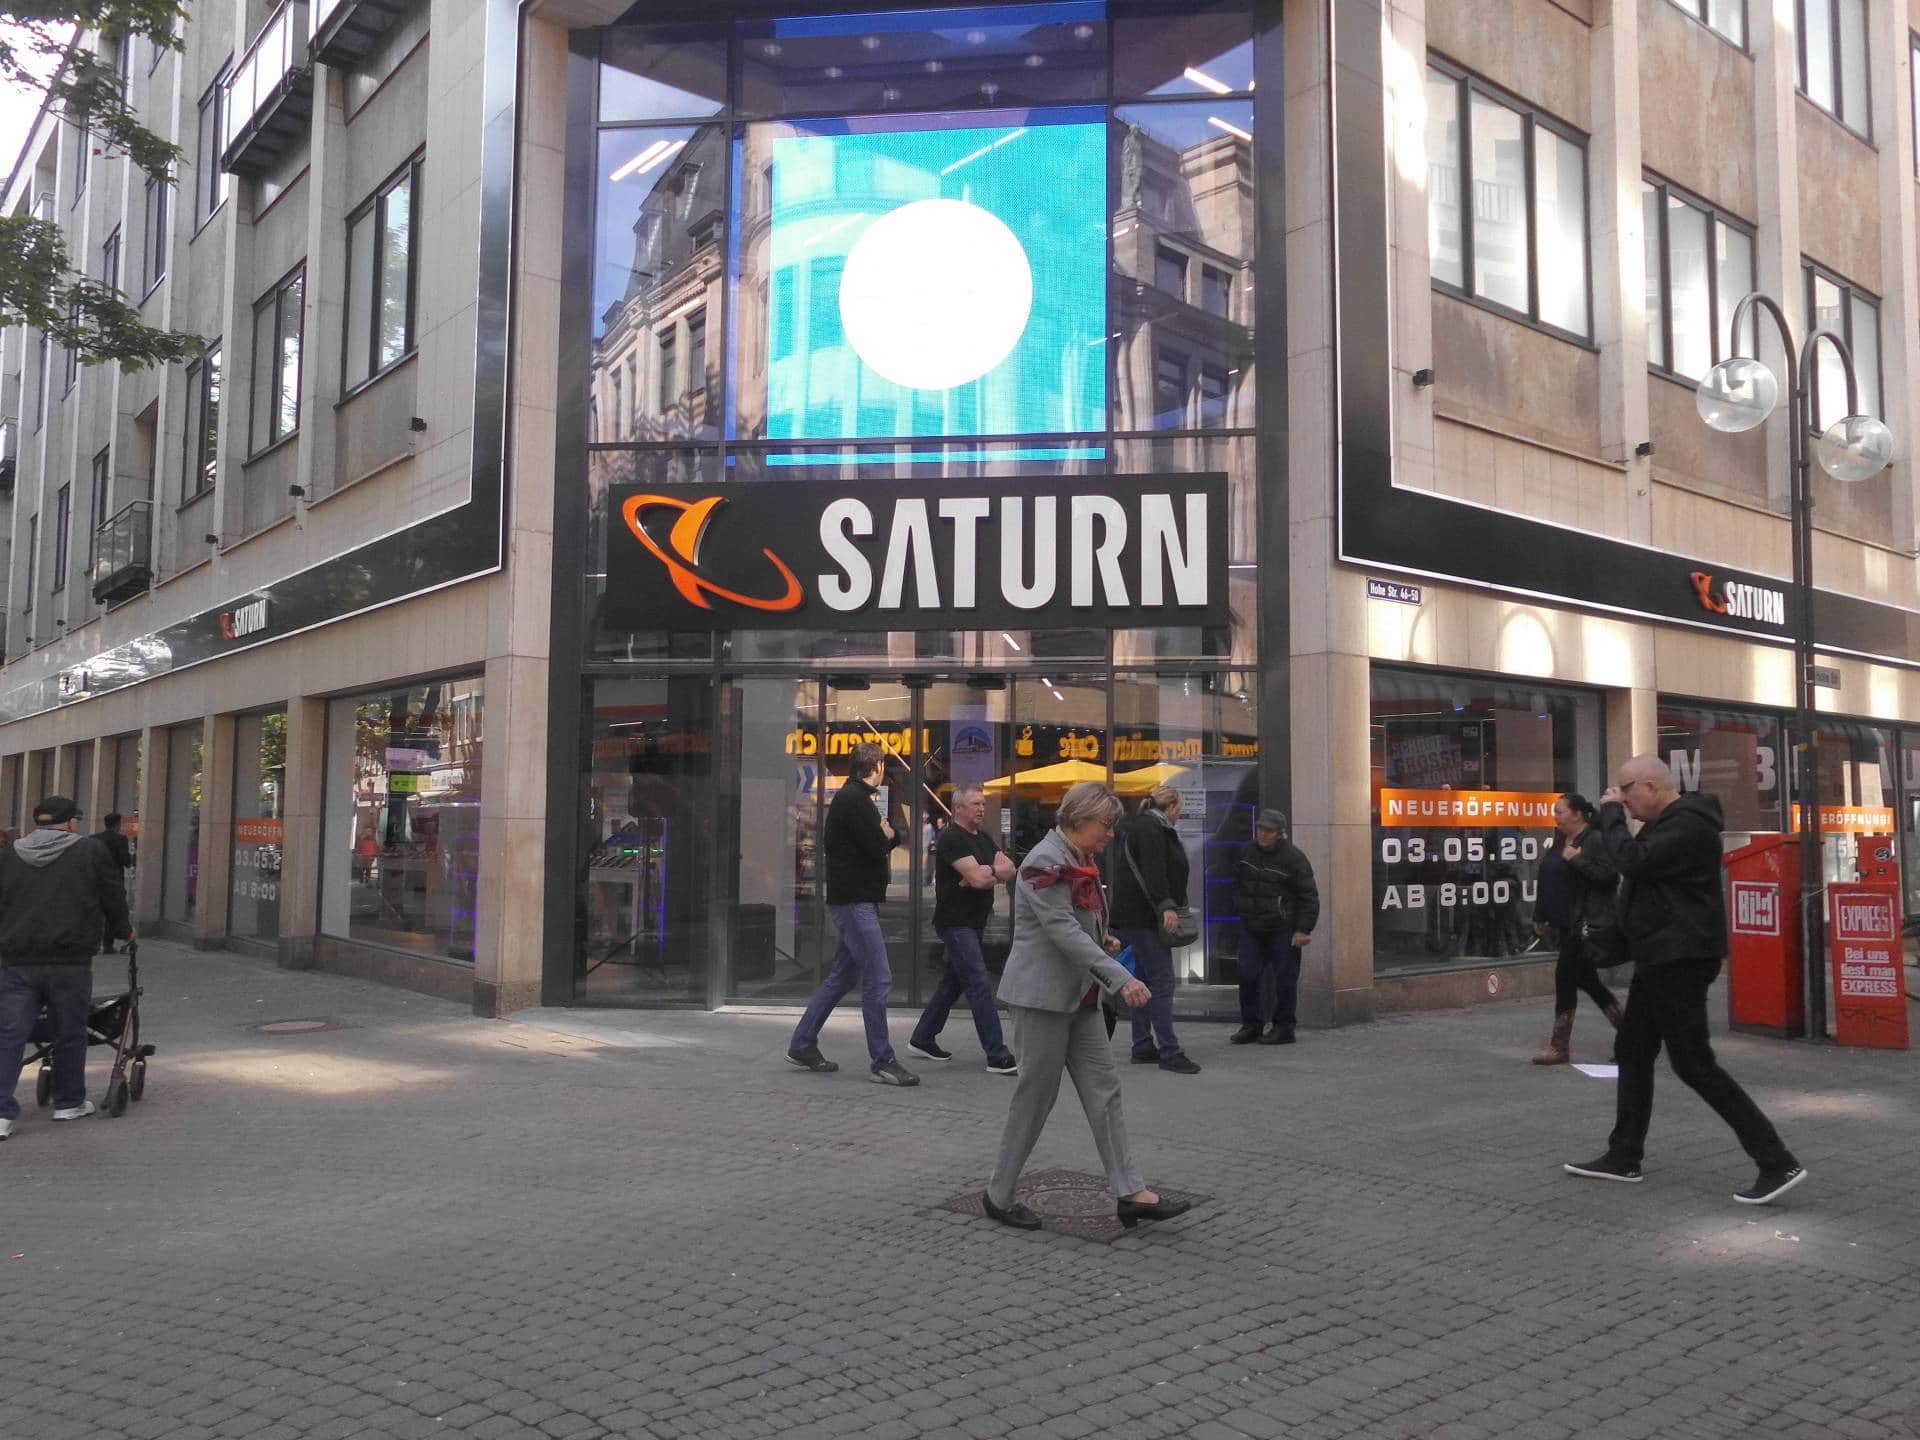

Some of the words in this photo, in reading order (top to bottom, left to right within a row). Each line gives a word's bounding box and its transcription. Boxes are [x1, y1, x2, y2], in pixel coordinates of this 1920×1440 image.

[818, 493, 1207, 611] SATURN
[1370, 582, 1386, 596] Hohe
[1726, 581, 1785, 625] SATURN
[234, 599, 266, 638] SATURN
[1381, 884, 1425, 910] AB
[1440, 880, 1510, 906] 8:00
[1738, 889, 1773, 927] Bild
[1840, 905, 1889, 932] EXPRESS
[1845, 948, 1864, 962] Bei
[1867, 949, 1889, 962] uns
[1841, 963, 1865, 977] liest
[1869, 965, 1896, 977] man
[1841, 979, 1897, 994] EXPRESS
